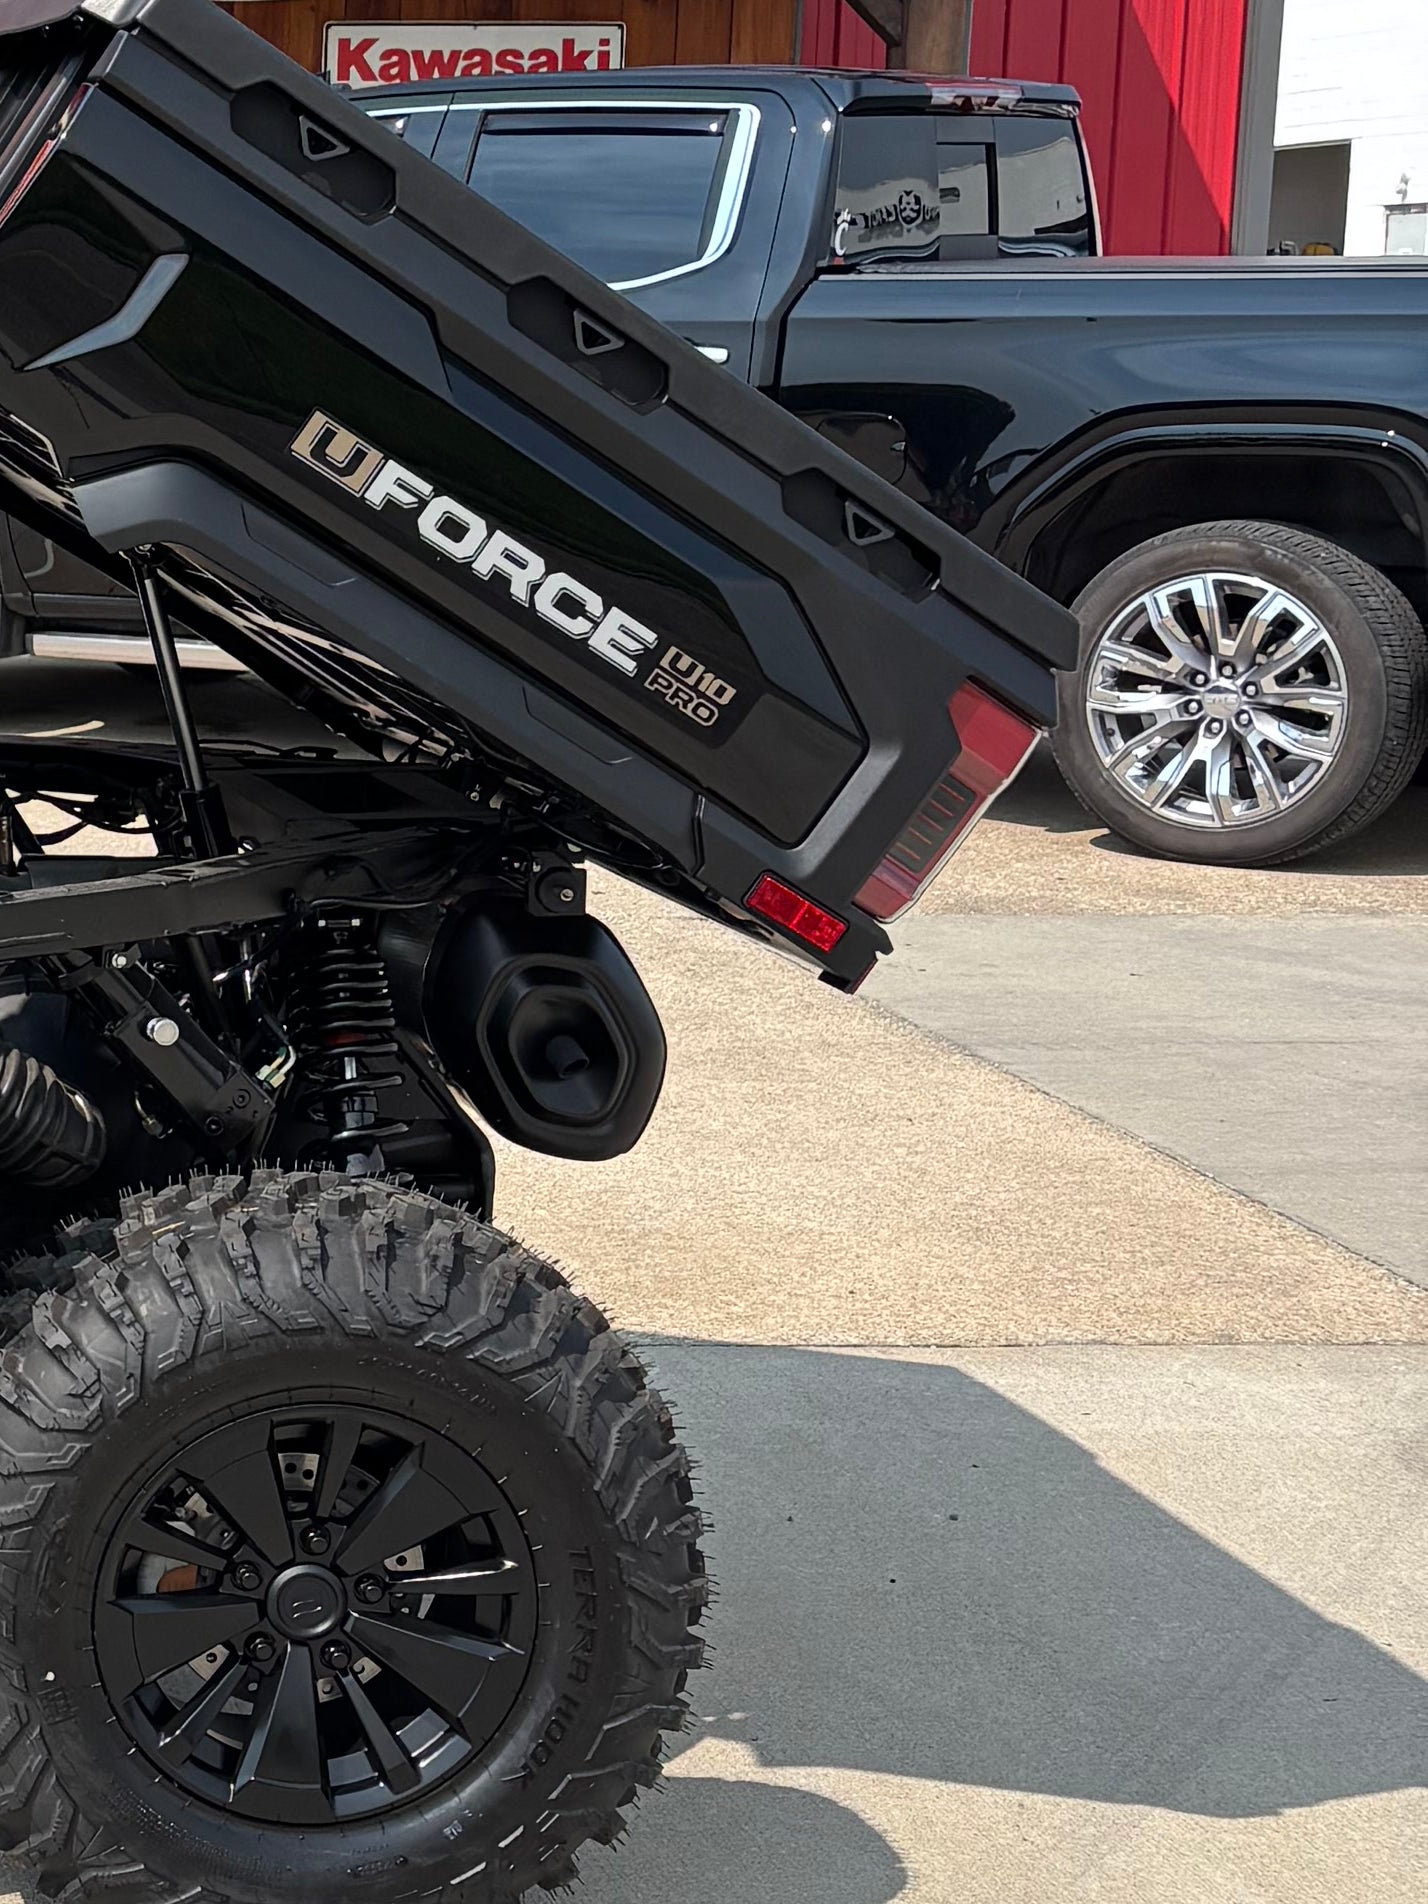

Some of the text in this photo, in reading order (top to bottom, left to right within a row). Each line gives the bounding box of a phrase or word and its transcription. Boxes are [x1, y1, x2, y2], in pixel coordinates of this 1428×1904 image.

[337, 38, 610, 82] Kawasaki
[290, 409, 658, 678] UFORCE
[644, 667, 720, 727] PRO
[659, 645, 737, 706] U10
[568, 1546, 597, 1683] TERRA
